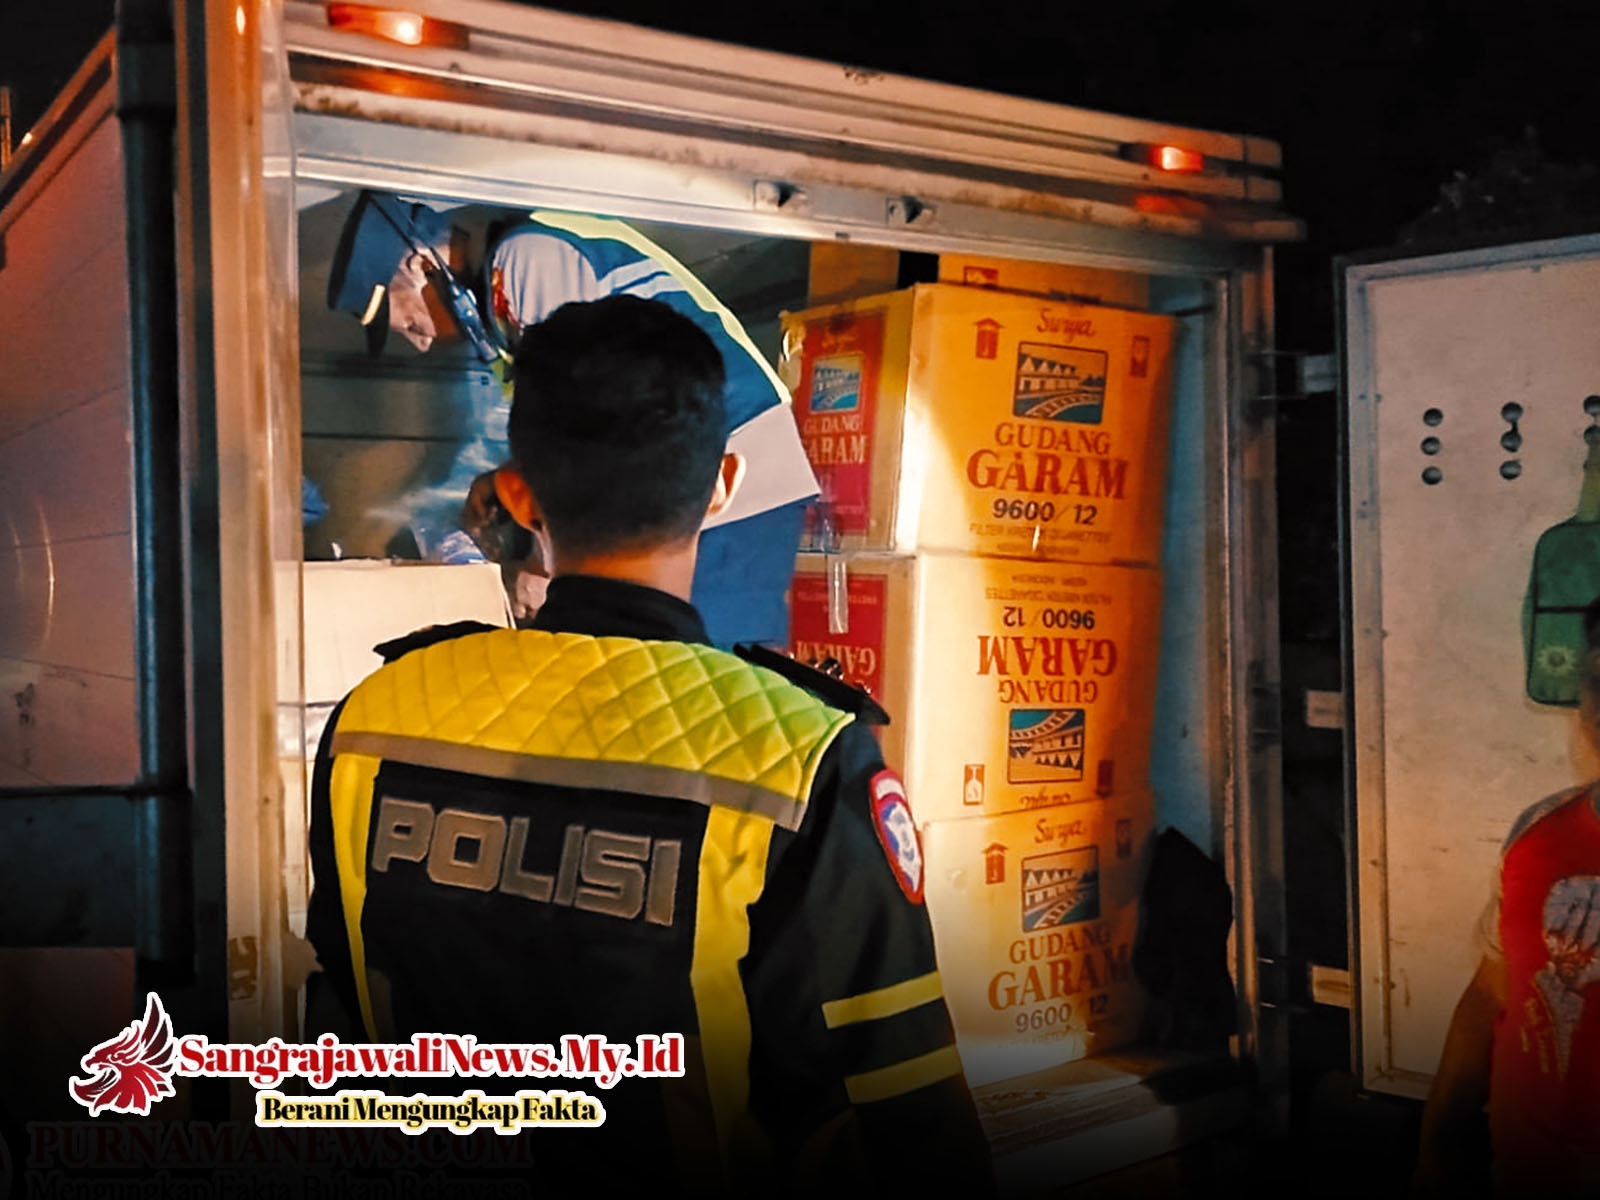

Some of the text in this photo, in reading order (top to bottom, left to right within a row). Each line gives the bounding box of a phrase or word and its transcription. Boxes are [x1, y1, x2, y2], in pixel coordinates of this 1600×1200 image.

[1035, 307, 1096, 343] Surya
[802, 435, 868, 464] ARAM
[994, 422, 1112, 456] GUDANG
[966, 448, 1130, 500] GARAM
[977, 635, 1117, 677] GARAM
[998, 679, 1099, 704] GUDANG
[1034, 818, 1087, 845] Surya
[372, 796, 682, 926] POLISI
[1009, 926, 1112, 965] GUDANG
[988, 944, 1131, 1011] GARAM
